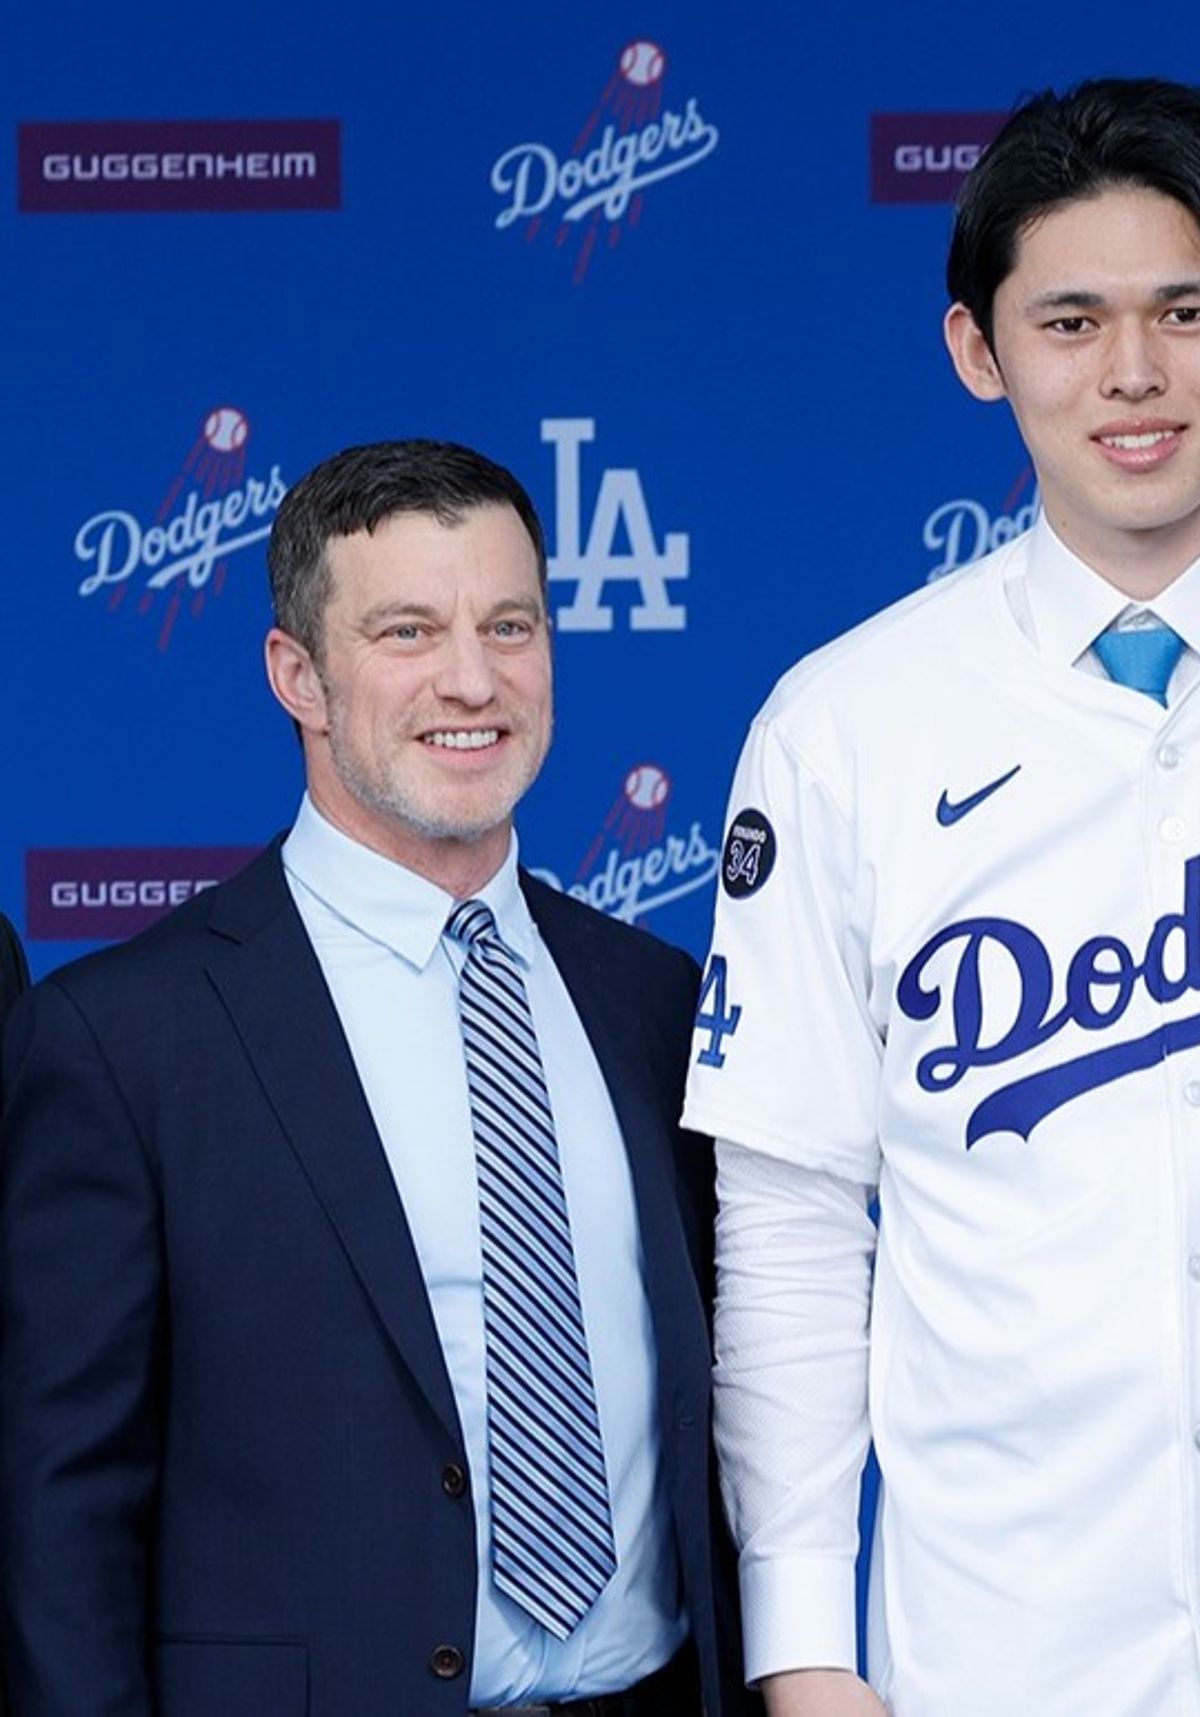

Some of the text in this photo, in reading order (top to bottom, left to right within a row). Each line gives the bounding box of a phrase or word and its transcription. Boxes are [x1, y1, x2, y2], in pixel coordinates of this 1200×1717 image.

[43, 152, 316, 181] GUGGENHEIM
[491, 98, 717, 229] Dodgers
[74, 464, 287, 596] Dodgers
[541, 418, 690, 632] LA
[727, 840, 760, 885] 34
